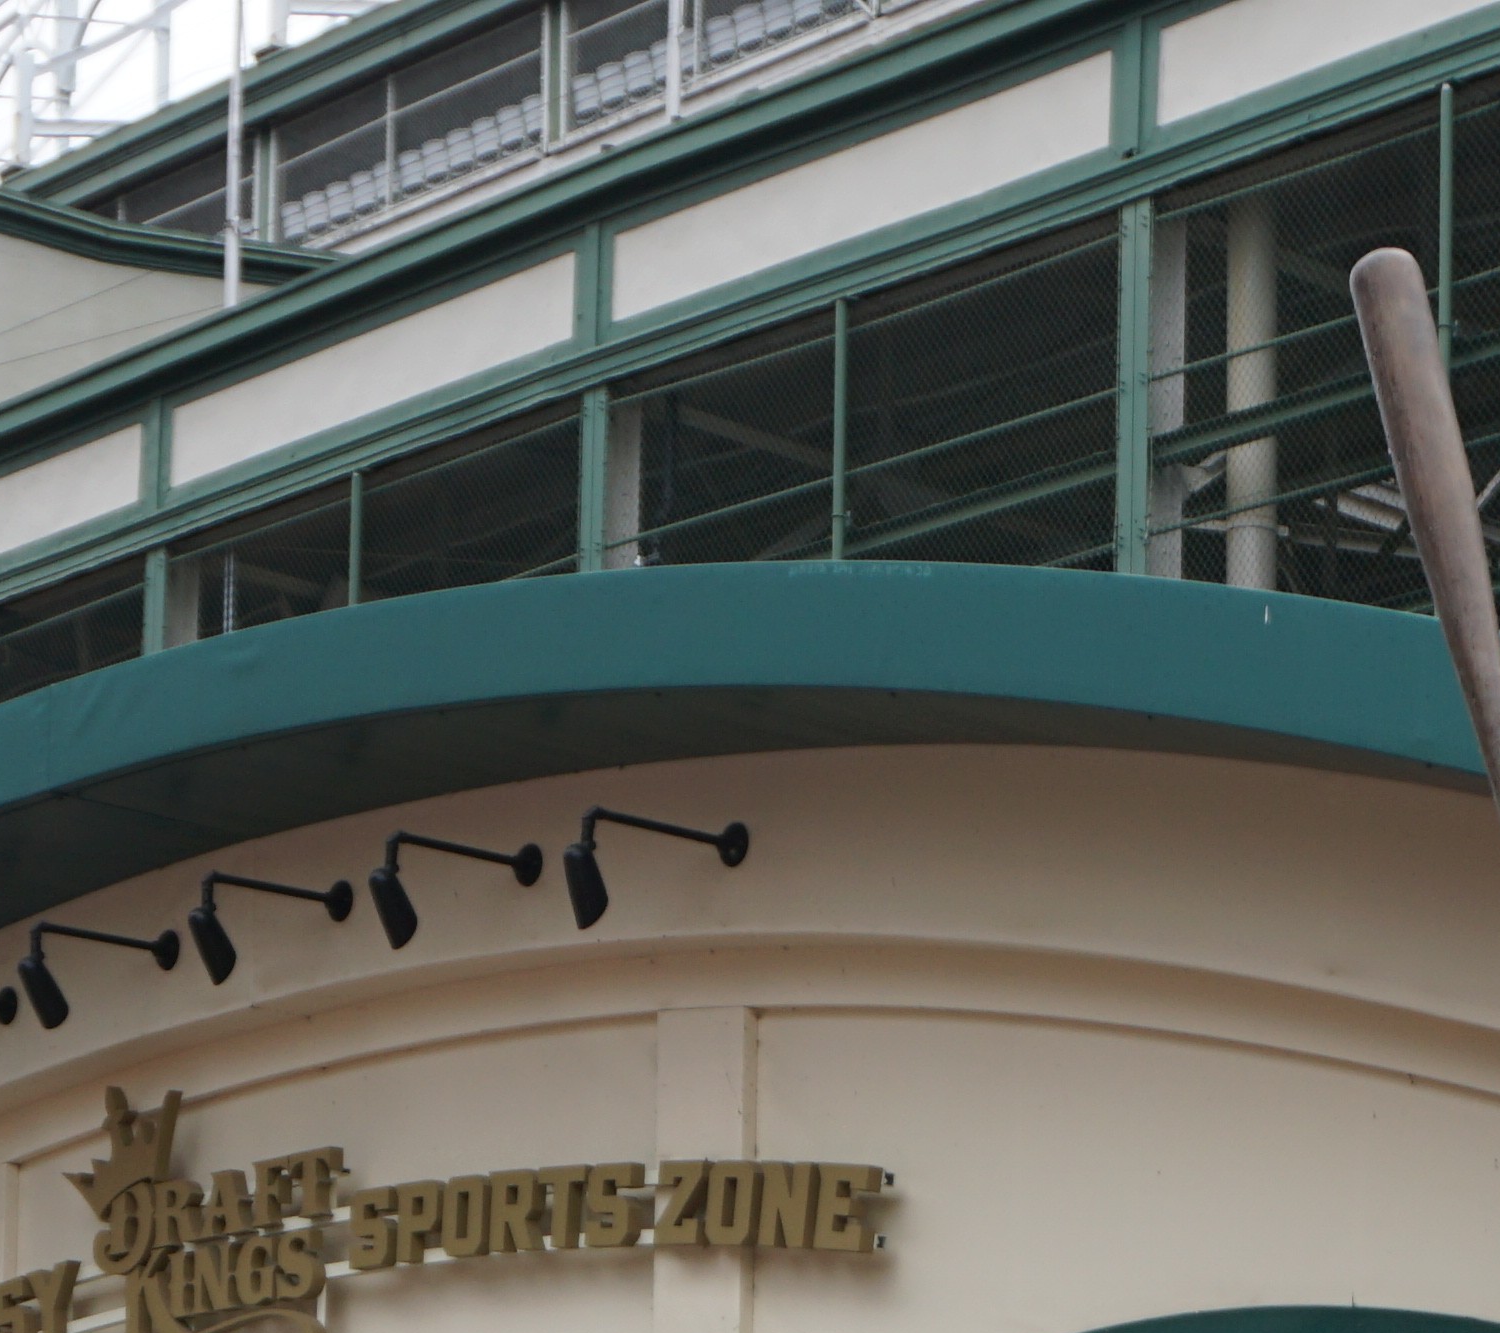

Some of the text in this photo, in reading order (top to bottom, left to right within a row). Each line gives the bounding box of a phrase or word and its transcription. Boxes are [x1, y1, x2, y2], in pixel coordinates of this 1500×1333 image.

[93, 1146, 349, 1275] DRAFT
[348, 1160, 884, 1270] SPORTS ZONE
